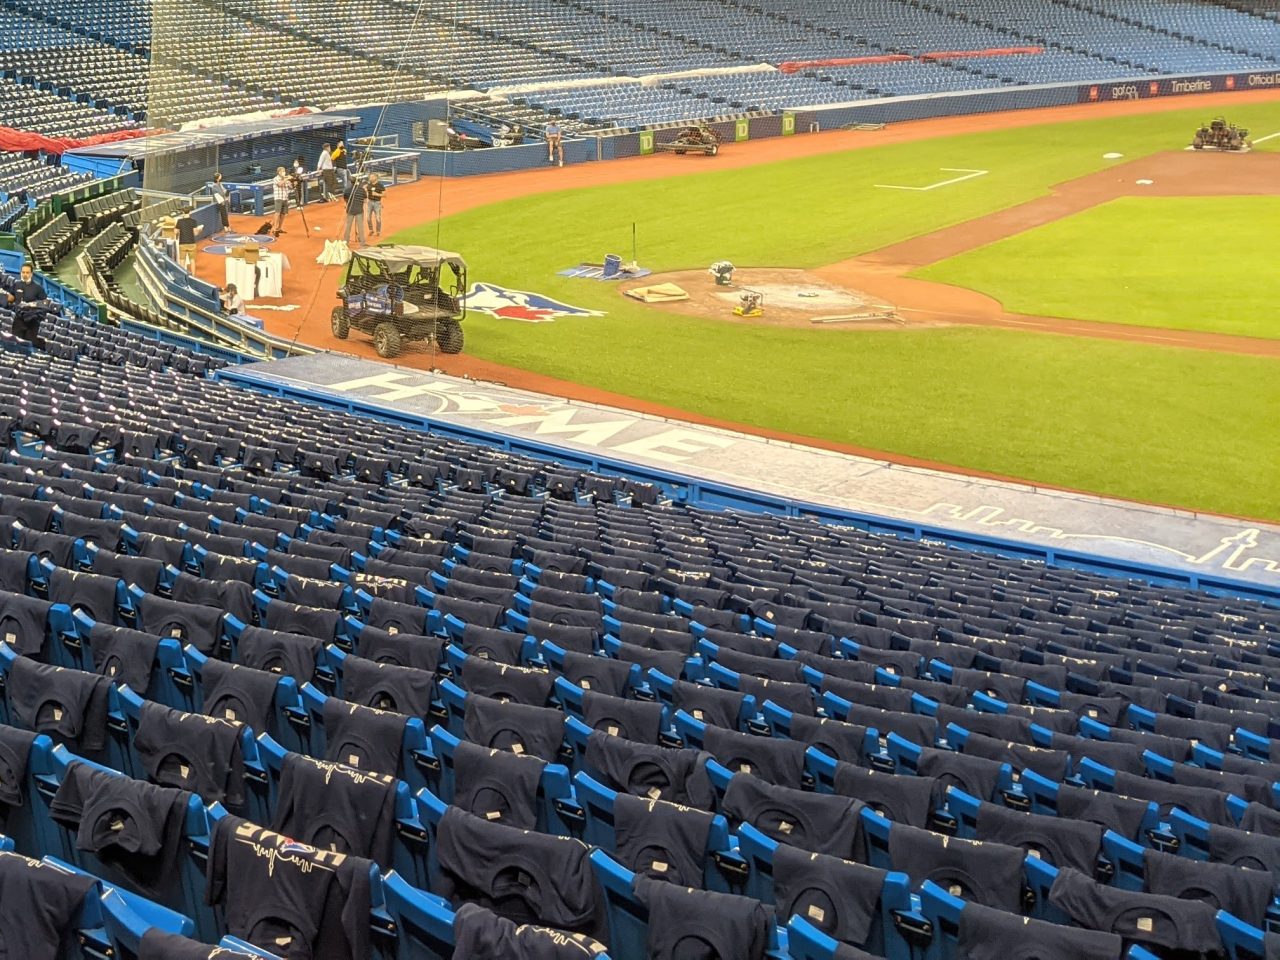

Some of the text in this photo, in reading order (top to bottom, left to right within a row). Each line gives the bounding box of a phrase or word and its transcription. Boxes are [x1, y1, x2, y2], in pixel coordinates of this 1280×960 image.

[1171, 79, 1212, 94] Timberline
[1248, 73, 1275, 87] Official
[738, 123, 748, 137] TD
[783, 117, 794, 131] TD
[642, 135, 653, 150] TD
